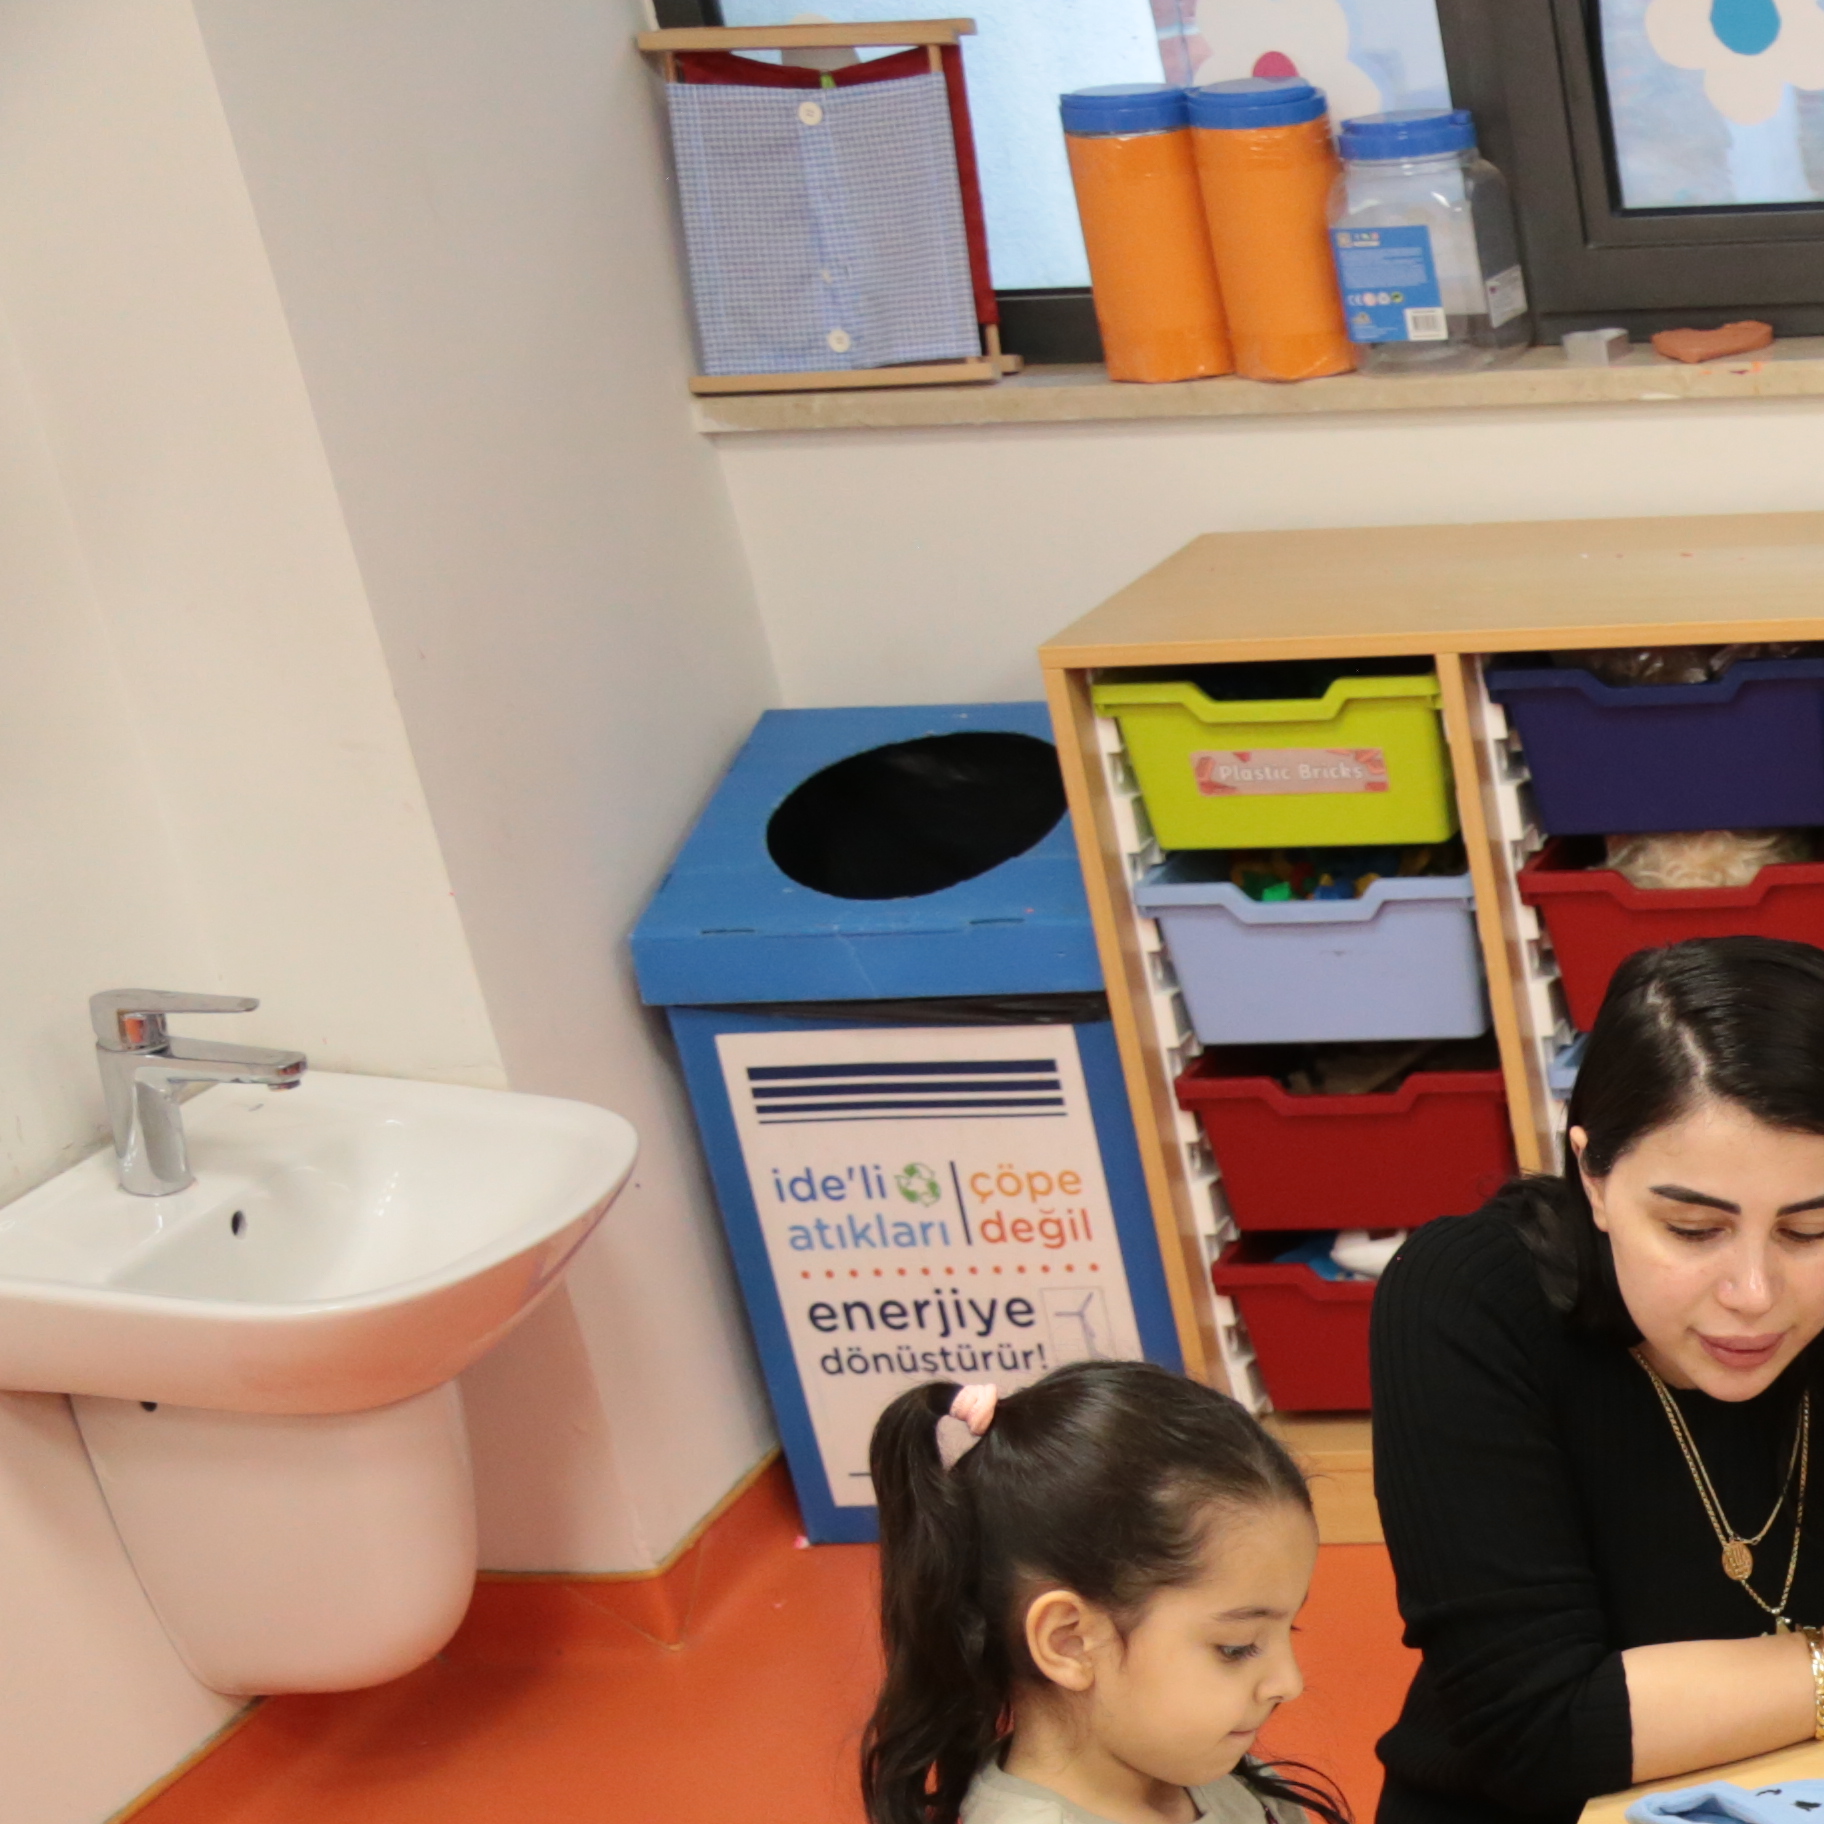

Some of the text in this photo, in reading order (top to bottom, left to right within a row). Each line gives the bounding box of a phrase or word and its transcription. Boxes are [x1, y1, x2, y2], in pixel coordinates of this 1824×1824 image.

[1219, 762, 1363, 781] Plastic Bricks
[772, 1164, 888, 1202] ide'li
[969, 1163, 1082, 1203] çöpe
[788, 1212, 952, 1251] atıkları
[979, 1206, 1094, 1250] değil
[808, 1287, 1035, 1338] enerjiye
